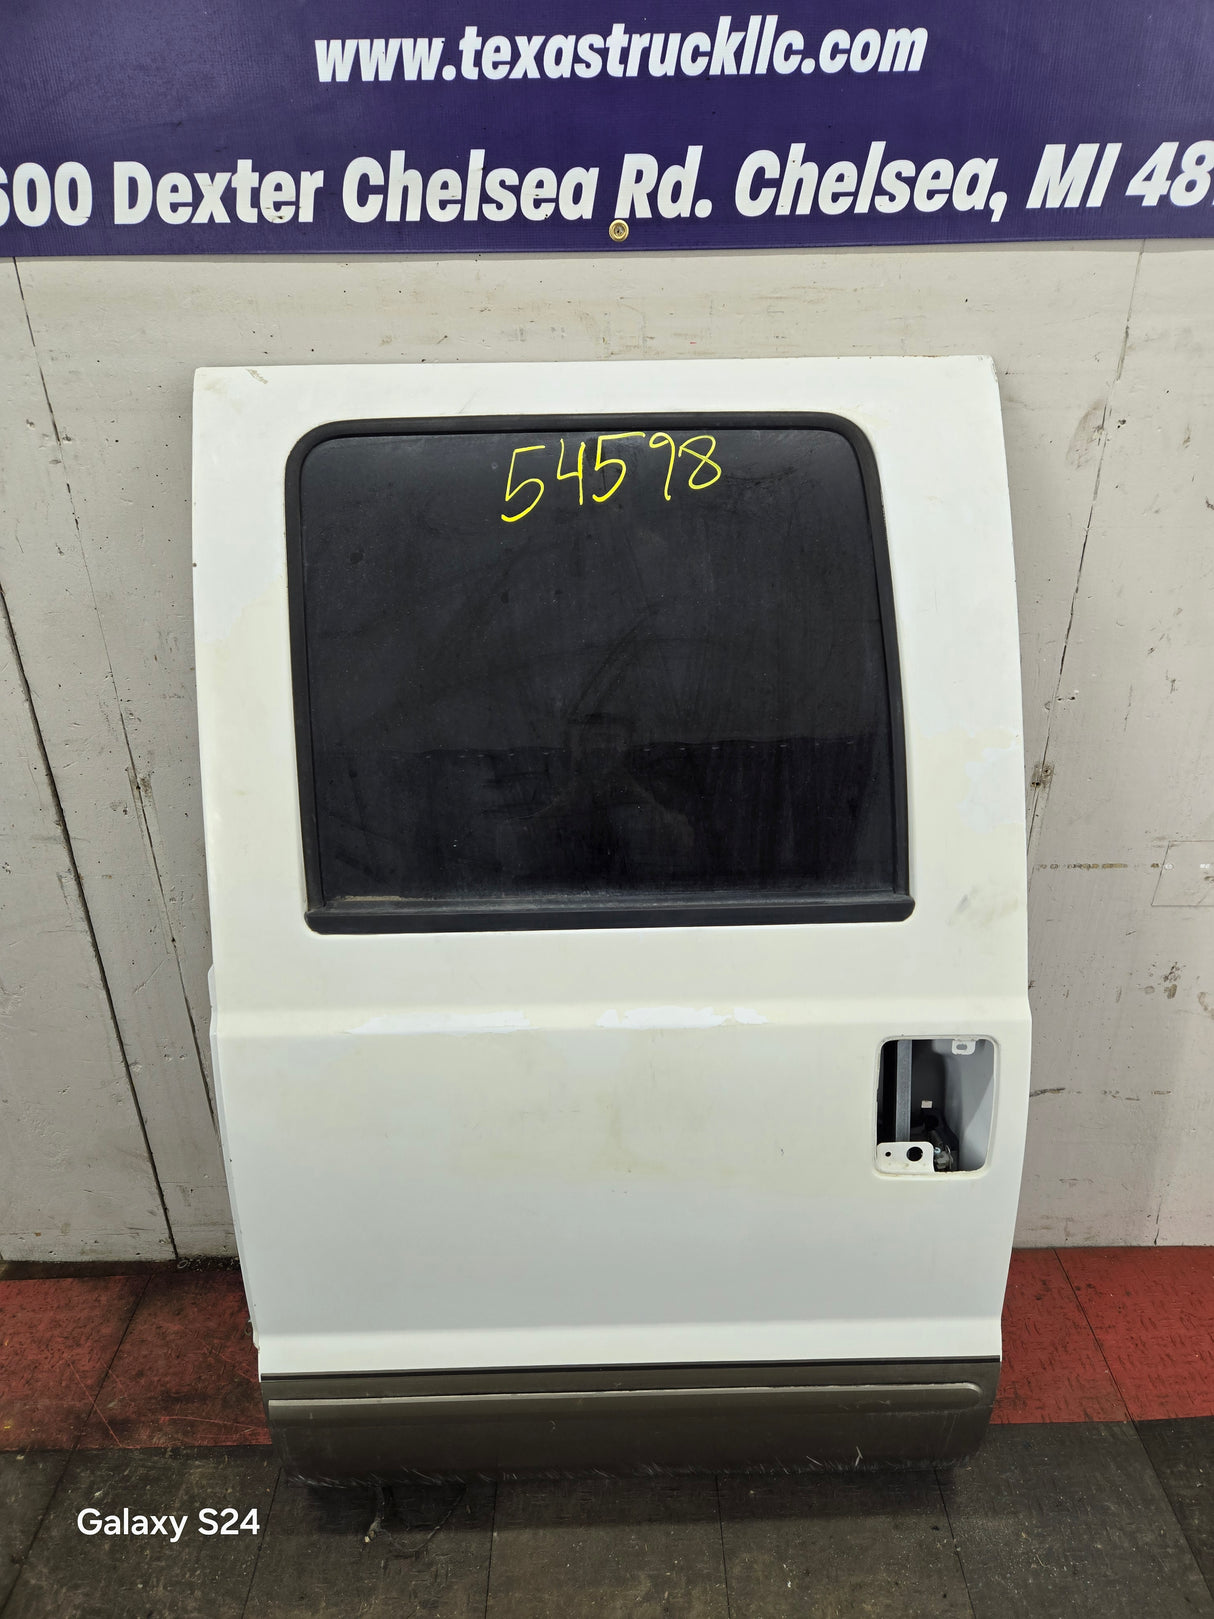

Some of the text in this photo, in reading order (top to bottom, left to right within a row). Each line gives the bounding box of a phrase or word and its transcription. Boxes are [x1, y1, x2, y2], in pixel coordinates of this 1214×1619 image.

[314, 14, 929, 83] www.texastruckllc.com
[0, 139, 1214, 228] 00 Dexter Chelsea Rd. Chelsea, MI 48
[501, 431, 722, 523] 54598
